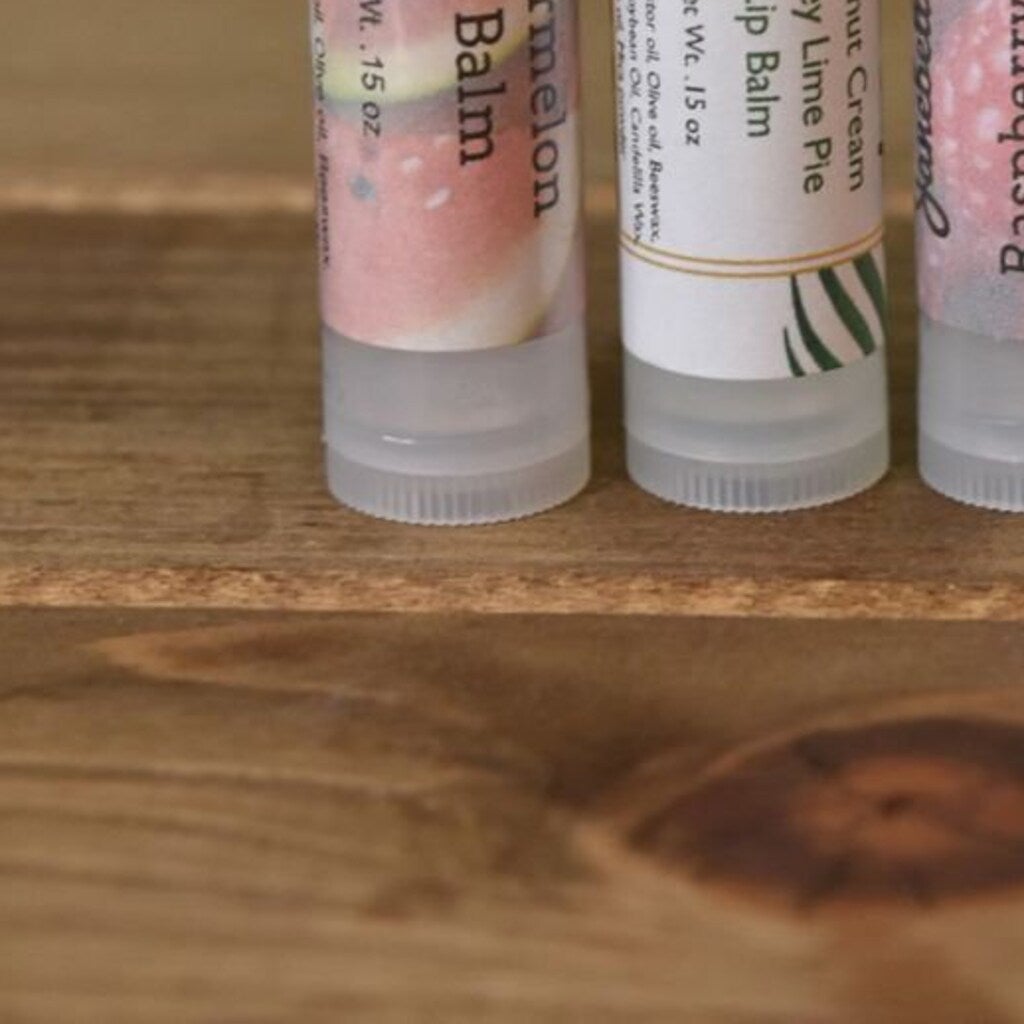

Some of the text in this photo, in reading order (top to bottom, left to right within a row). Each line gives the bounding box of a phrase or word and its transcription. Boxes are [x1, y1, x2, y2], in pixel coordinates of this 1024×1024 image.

[358, 43, 384, 94] .15
[455, 7, 509, 168] Balm
[683, 74, 707, 112] .15
[745, 51, 781, 139] Balm
[801, 37, 830, 128] Lime
[361, 101, 382, 138] oz
[645, 70, 663, 127] Olive
[646, 132, 663, 155] oil,
[683, 118, 703, 148] oz
[845, 65, 867, 193] Cream
[802, 139, 832, 195] Pie
